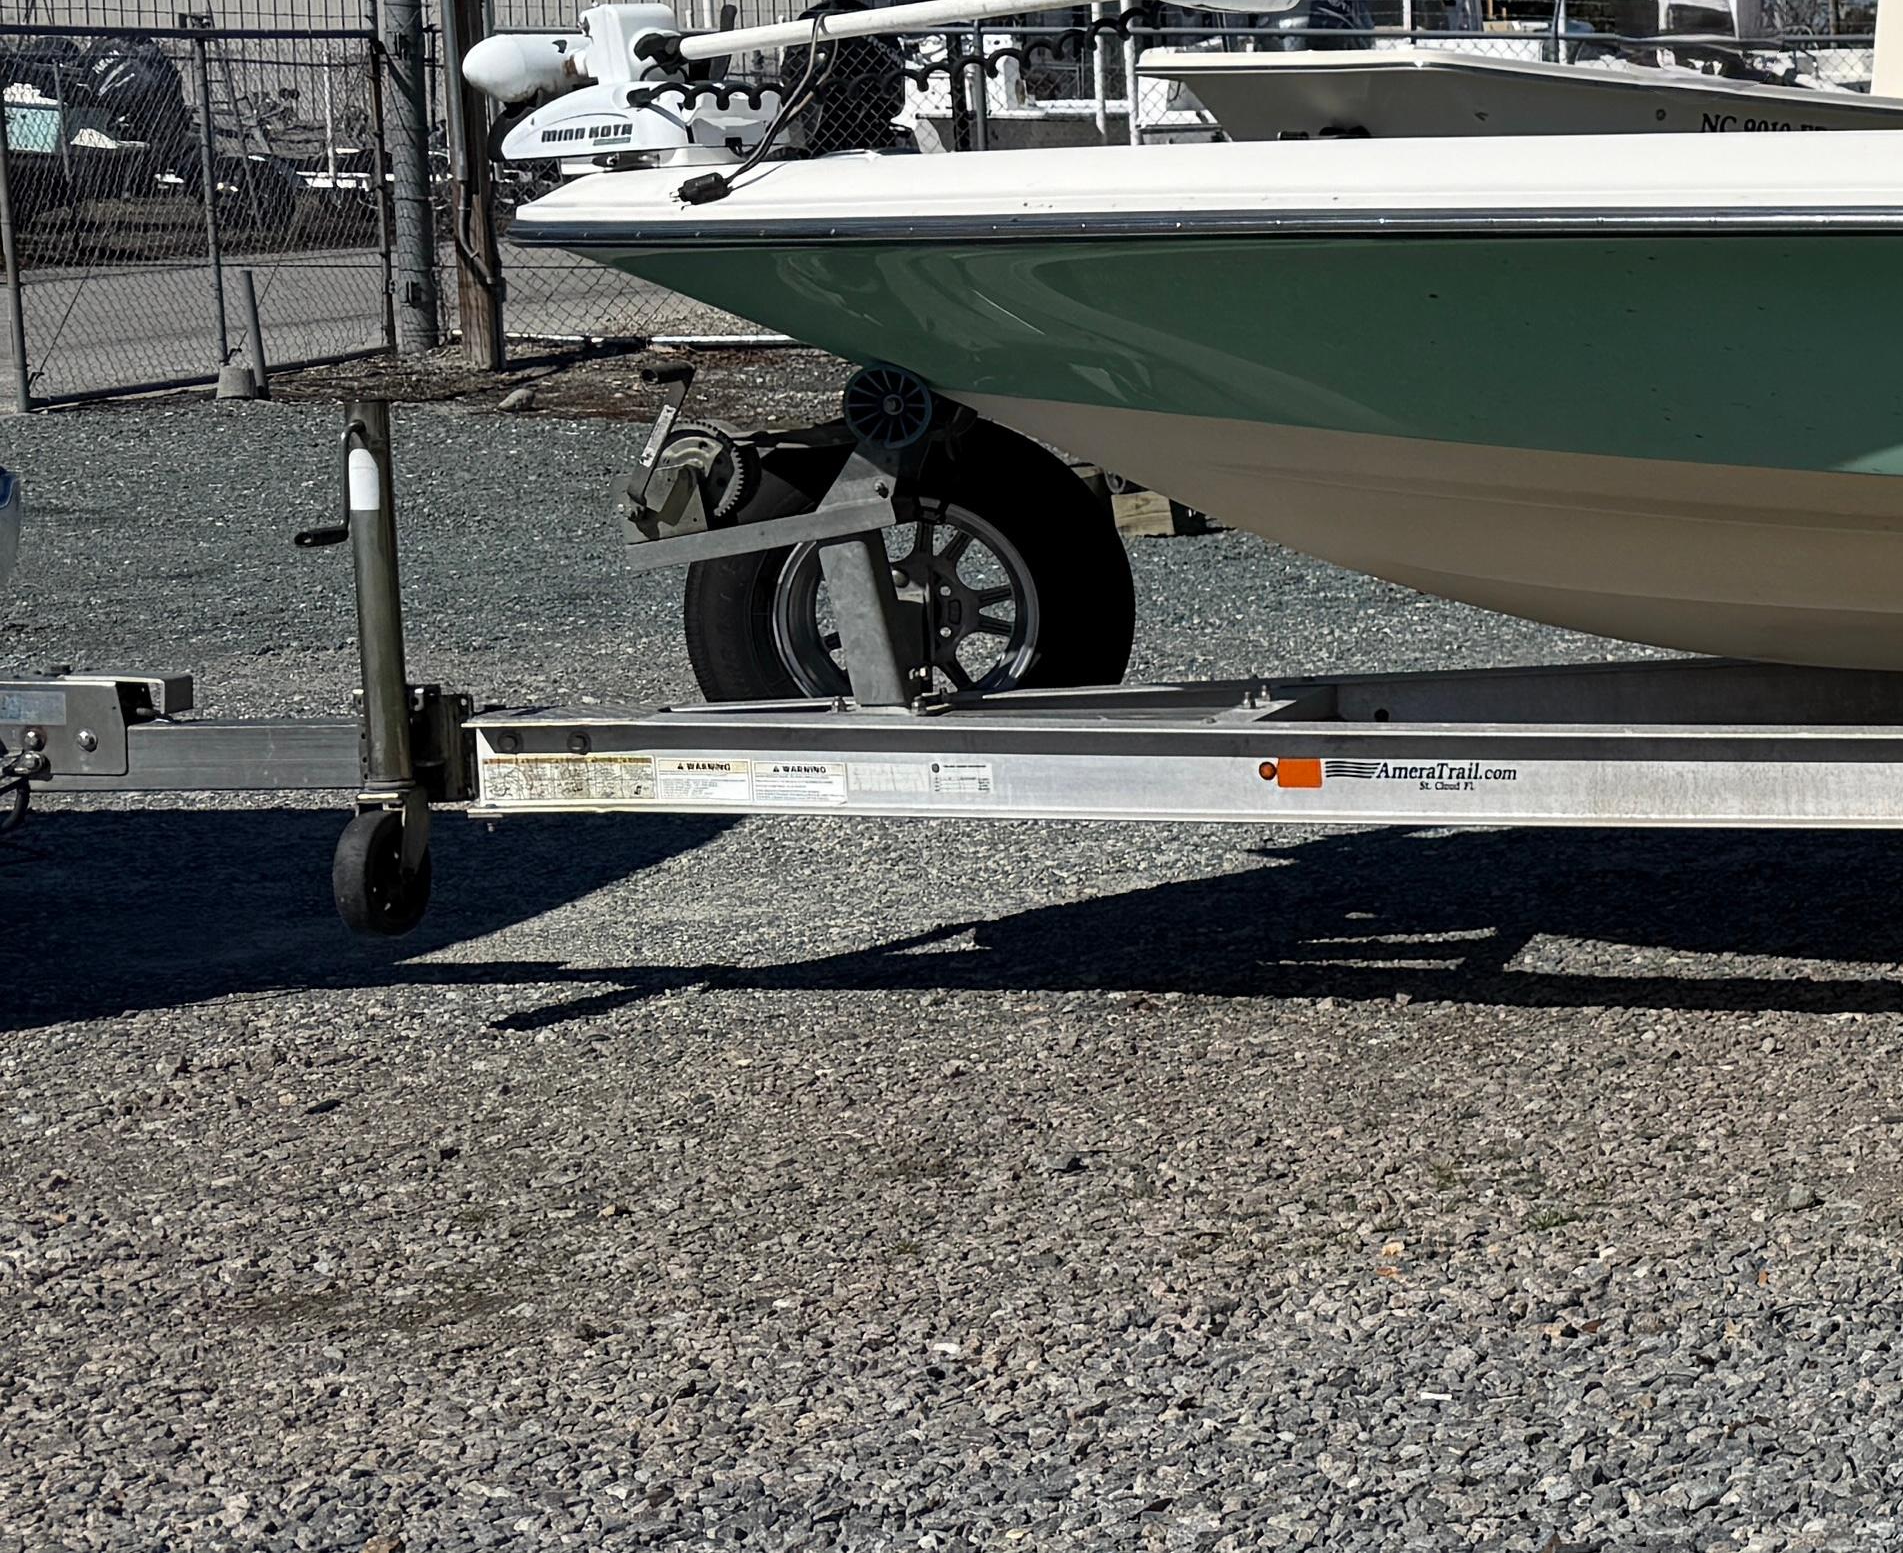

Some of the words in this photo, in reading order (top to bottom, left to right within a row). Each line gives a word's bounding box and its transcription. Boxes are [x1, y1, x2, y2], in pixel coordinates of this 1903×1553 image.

[1701, 113, 1737, 133] NC
[589, 124, 633, 138] KOTA
[686, 762, 731, 772] WARNING
[782, 765, 827, 774] WARNING
[1376, 762, 1517, 780] AmeraTrail.com
